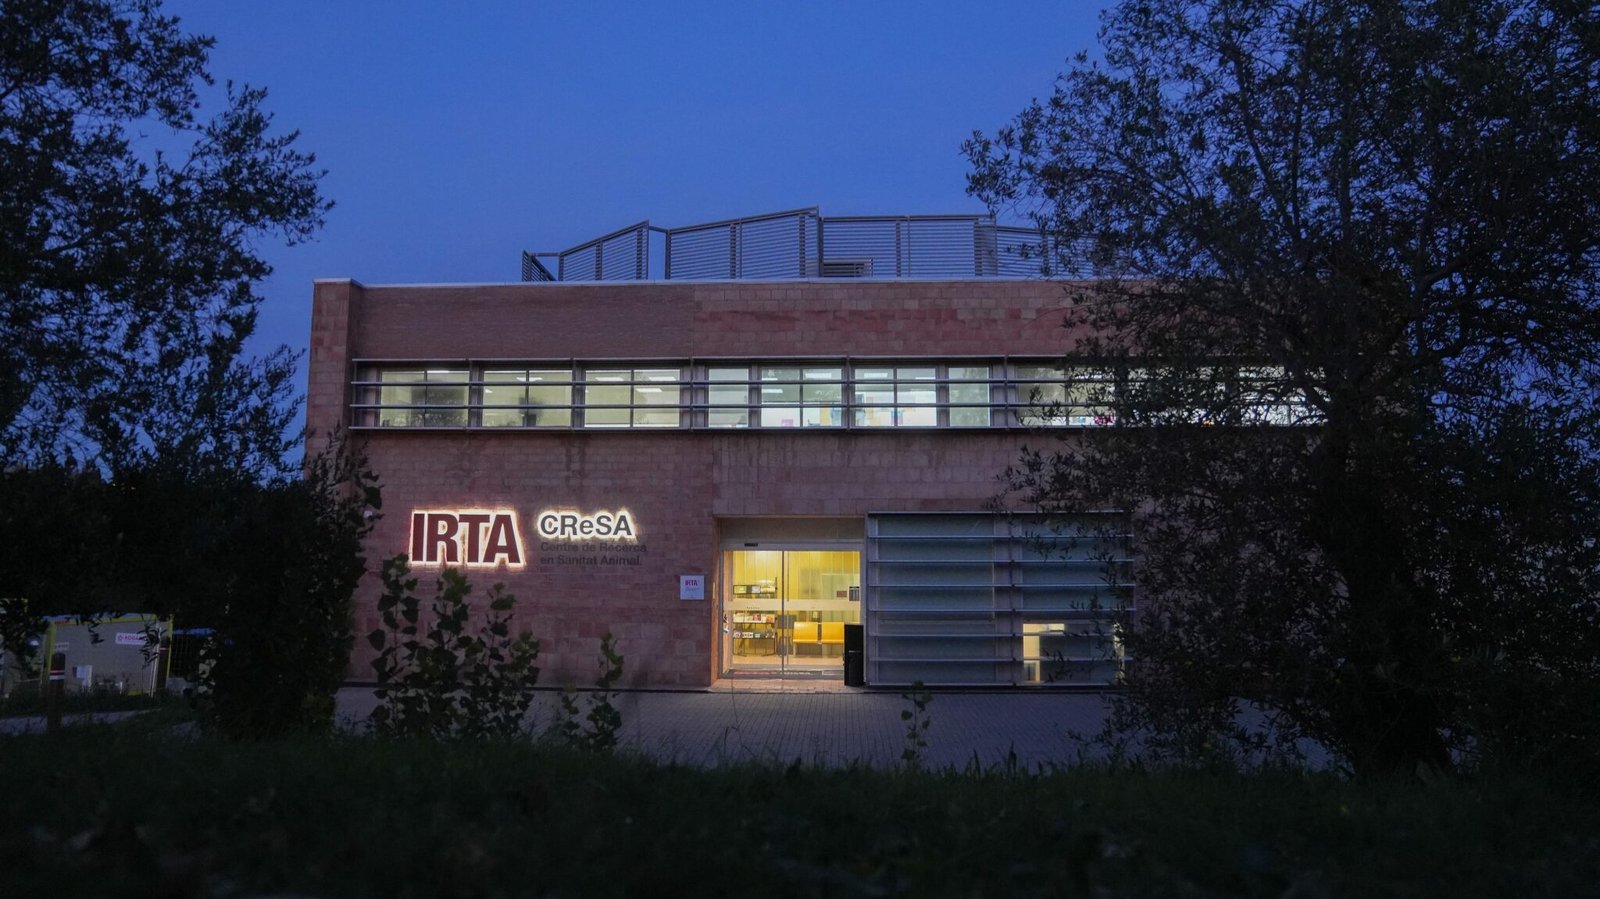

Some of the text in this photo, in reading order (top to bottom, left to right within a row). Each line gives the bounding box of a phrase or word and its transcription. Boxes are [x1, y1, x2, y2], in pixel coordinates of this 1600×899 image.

[540, 514, 632, 536] CReSA
[412, 513, 520, 563] IRTA
[540, 541, 647, 552] Centre de Recerca
[540, 556, 553, 564] en
[557, 554, 597, 565] Sanitat
